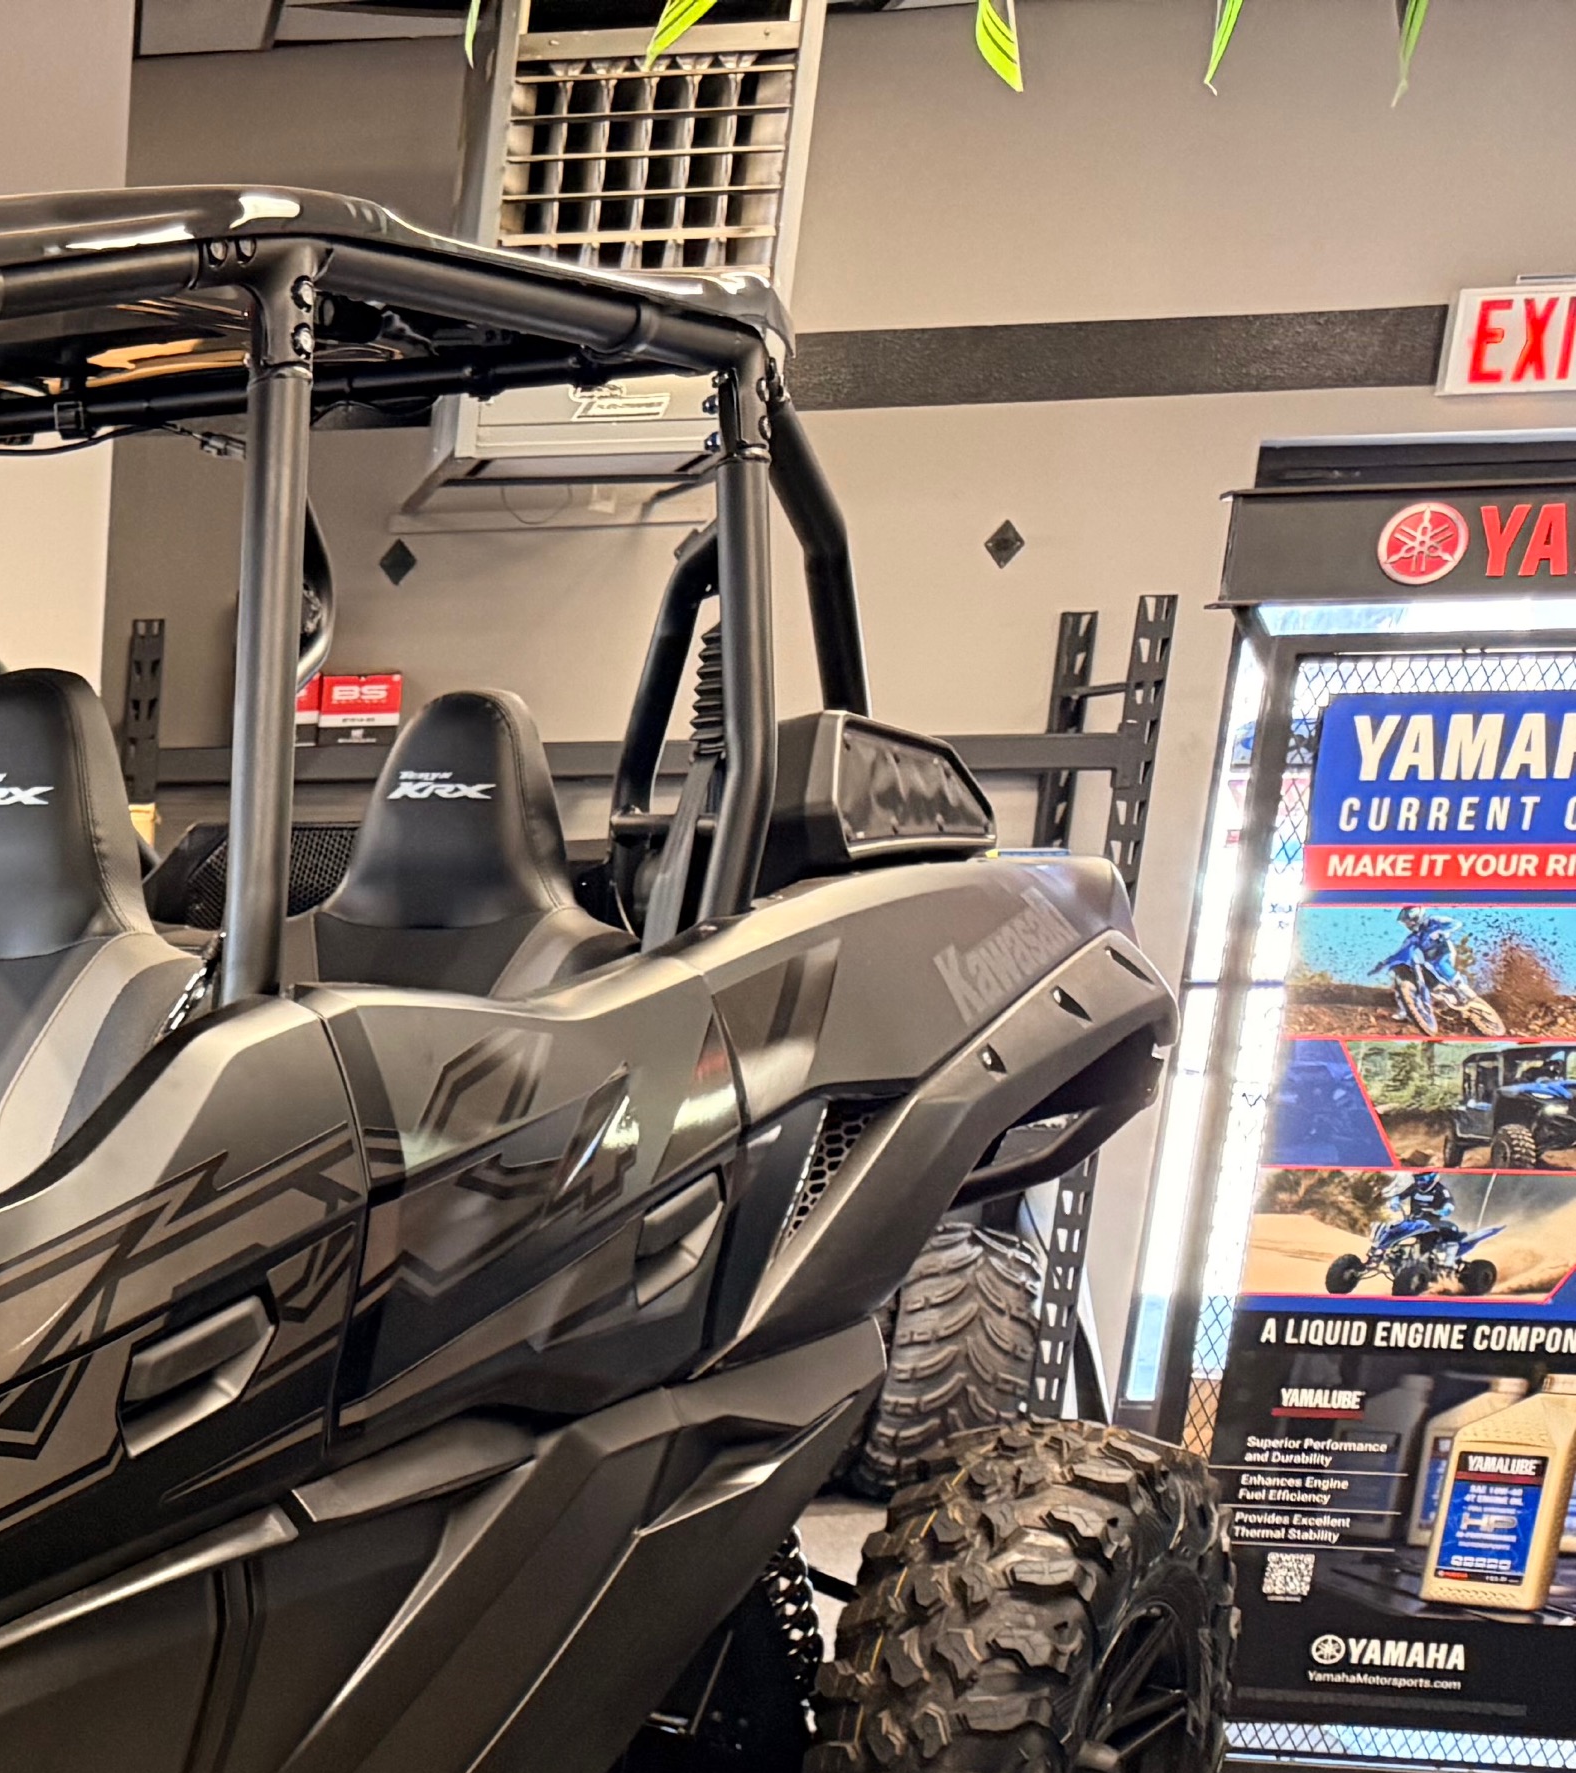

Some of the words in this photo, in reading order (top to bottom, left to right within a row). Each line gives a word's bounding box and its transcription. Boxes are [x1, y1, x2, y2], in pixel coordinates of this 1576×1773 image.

[1480, 503, 1576, 577] YA
[331, 684, 390, 700] BS
[1339, 797, 1541, 832] CURRENT
[1327, 854, 1414, 877] MAKE
[1420, 854, 1451, 877] IT
[1457, 854, 1539, 877] YOUR
[933, 886, 1083, 1027] Kawasaki
[1260, 1317, 1277, 1343] A
[1285, 1318, 1368, 1346] LIQUID
[1374, 1321, 1467, 1350] ENGINE
[1473, 1324, 1576, 1354] COMPON
[1280, 1388, 1363, 1410] YAMALUBE
[1246, 1435, 1301, 1450] Superior
[1303, 1438, 1388, 1453] Performance
[1244, 1451, 1269, 1463] and
[1271, 1452, 1332, 1468] Durability
[1468, 1455, 1537, 1476] YAMALUBE
[1240, 1473, 1302, 1488] Enhances
[1305, 1476, 1349, 1491] Engine
[1238, 1488, 1266, 1500] Fuel
[1268, 1489, 1331, 1505] Efficiency
[1234, 1511, 1290, 1526] Provides
[1293, 1514, 1351, 1528] Excellent
[1233, 1526, 1285, 1539] Thermal
[1287, 1528, 1340, 1544] Stability
[1348, 1637, 1465, 1671] YAMAHA
[1307, 1669, 1462, 1690] YamahaMotorsports.com
